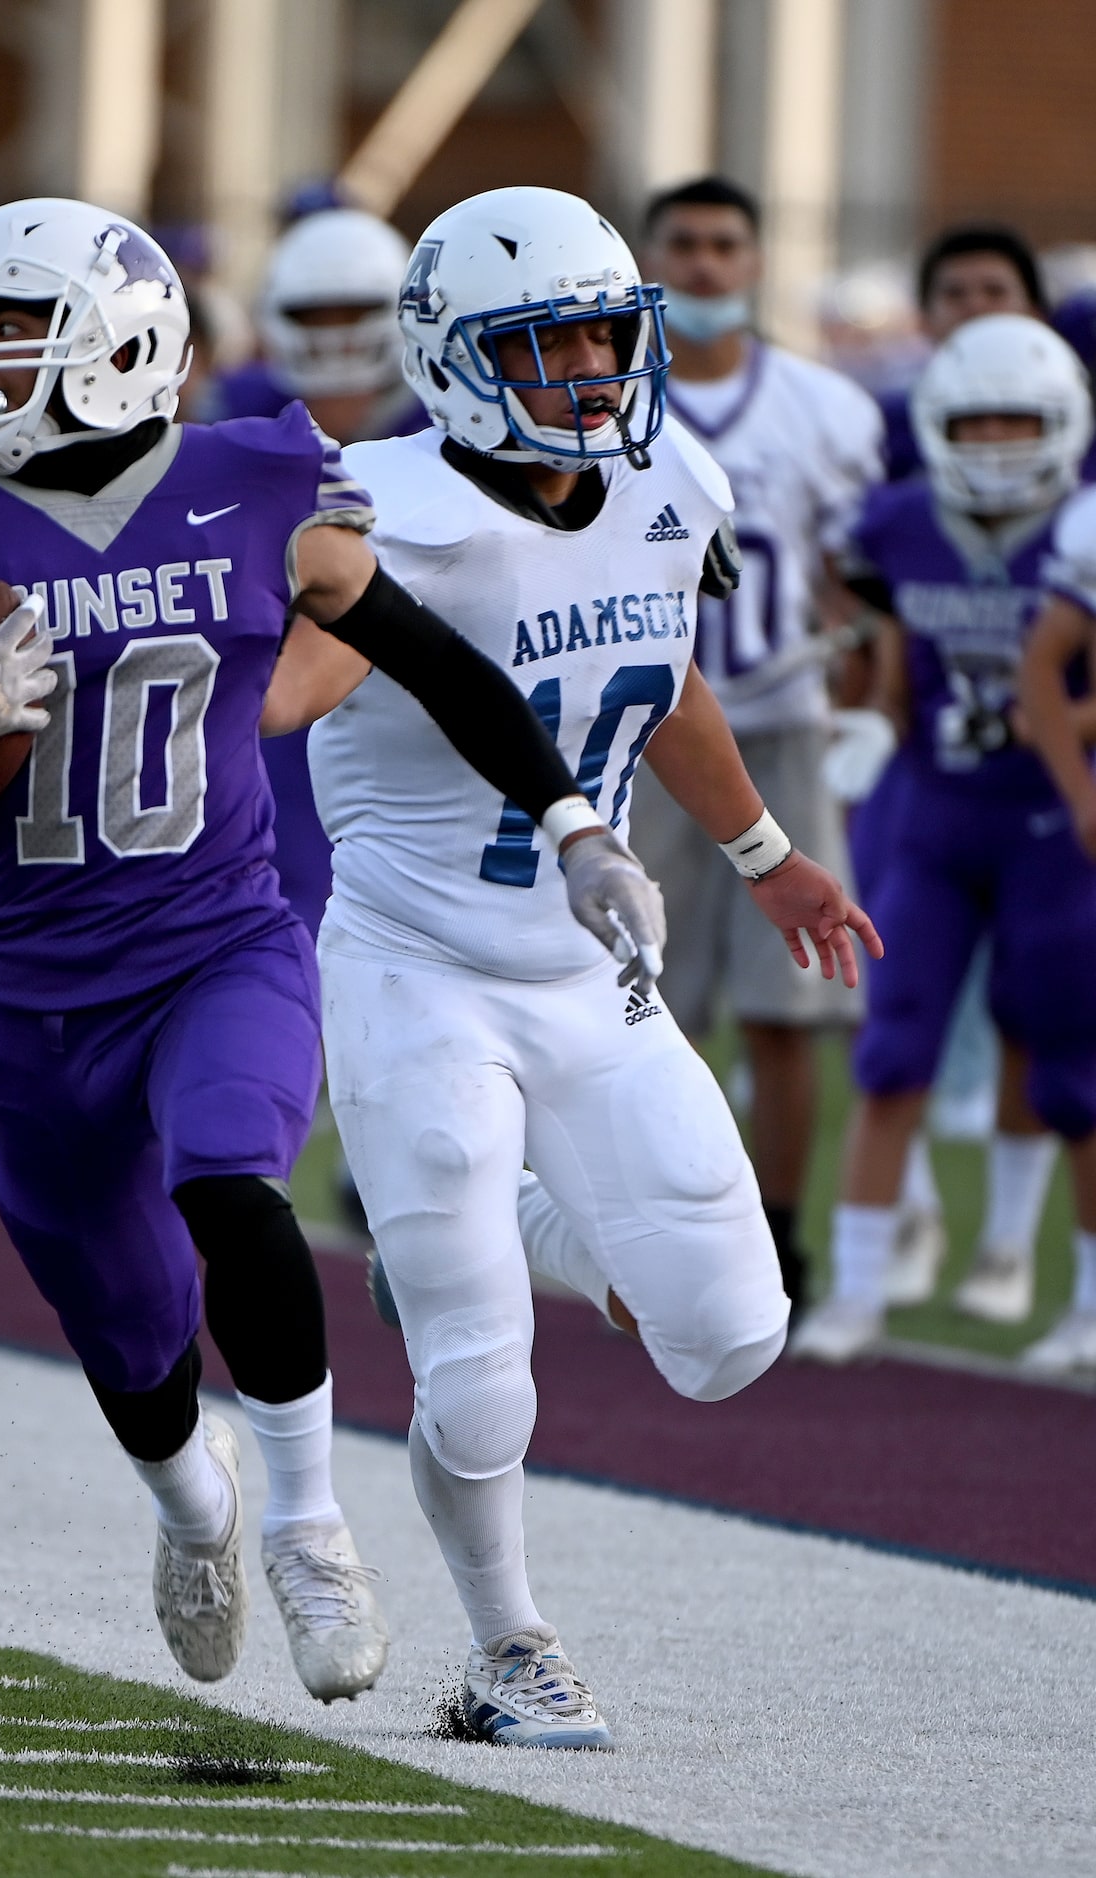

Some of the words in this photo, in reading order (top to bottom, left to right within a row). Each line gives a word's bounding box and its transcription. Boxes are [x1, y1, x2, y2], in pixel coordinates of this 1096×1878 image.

[644, 528, 690, 542] adidas
[512, 591, 689, 667] ADAMSON
[15, 633, 221, 866] 10
